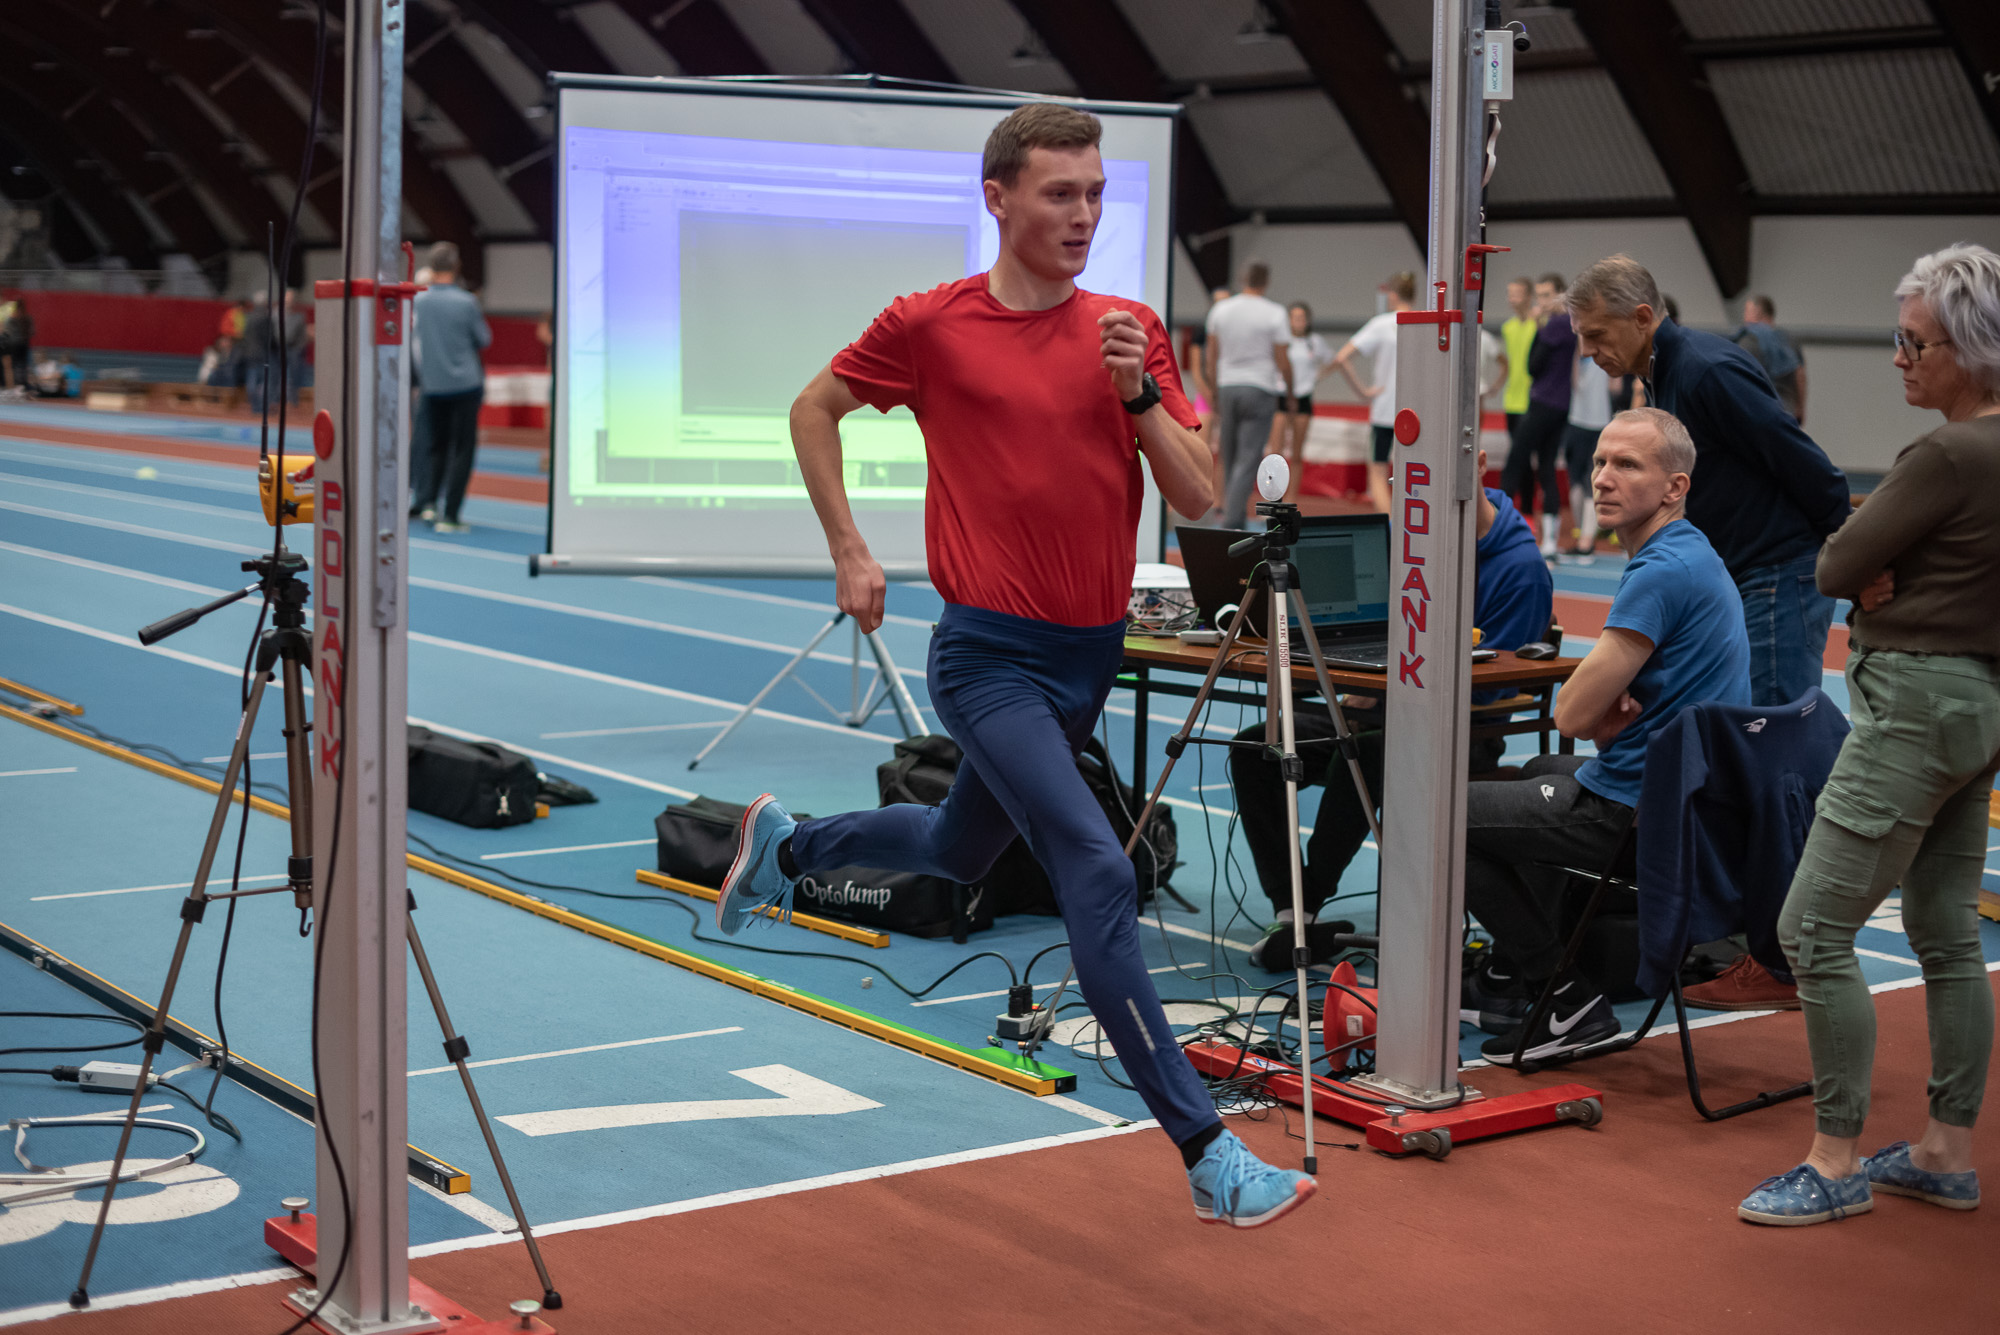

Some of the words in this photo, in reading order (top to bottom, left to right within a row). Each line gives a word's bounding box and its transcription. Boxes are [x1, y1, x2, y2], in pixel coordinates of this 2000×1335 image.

[322, 481, 342, 782] POLANIK
[1279, 642, 1289, 668] U5500
[1400, 462, 1431, 689] POLANIK
